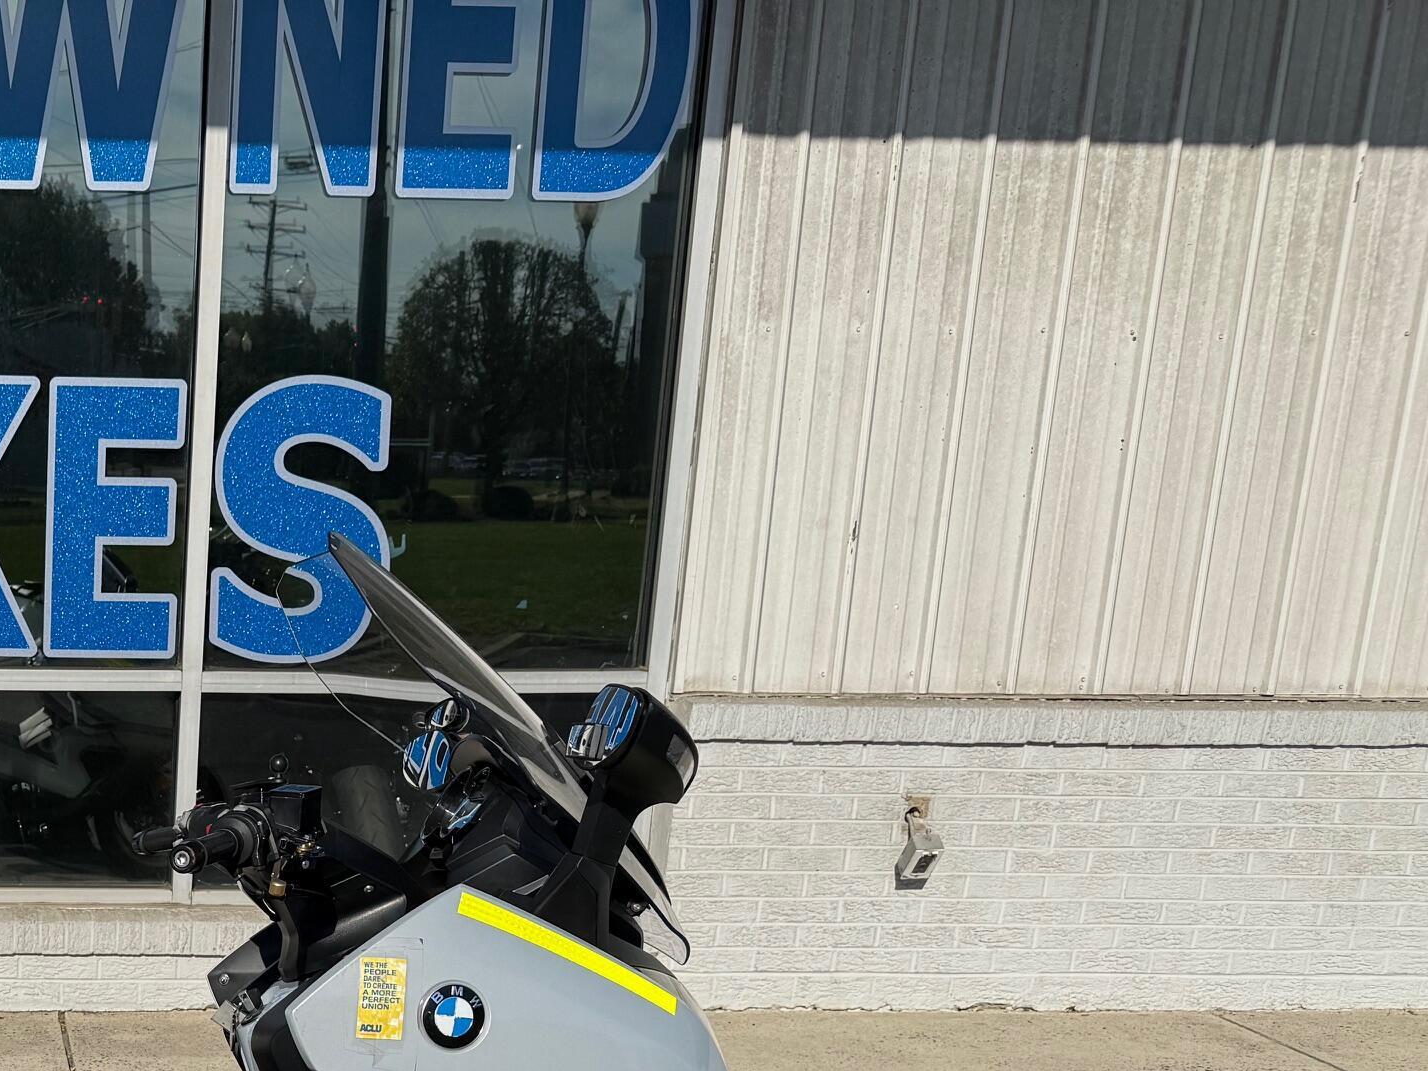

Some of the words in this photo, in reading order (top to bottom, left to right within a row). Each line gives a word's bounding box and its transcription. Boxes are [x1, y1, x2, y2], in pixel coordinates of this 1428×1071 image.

[363, 968, 397, 976] PEOPLE
[372, 982, 397, 990] CREATE
[371, 989, 397, 997] MORE
[430, 985, 482, 1009] BMW
[362, 996, 401, 1004] PERFECT
[359, 1024, 382, 1033] ACLU
